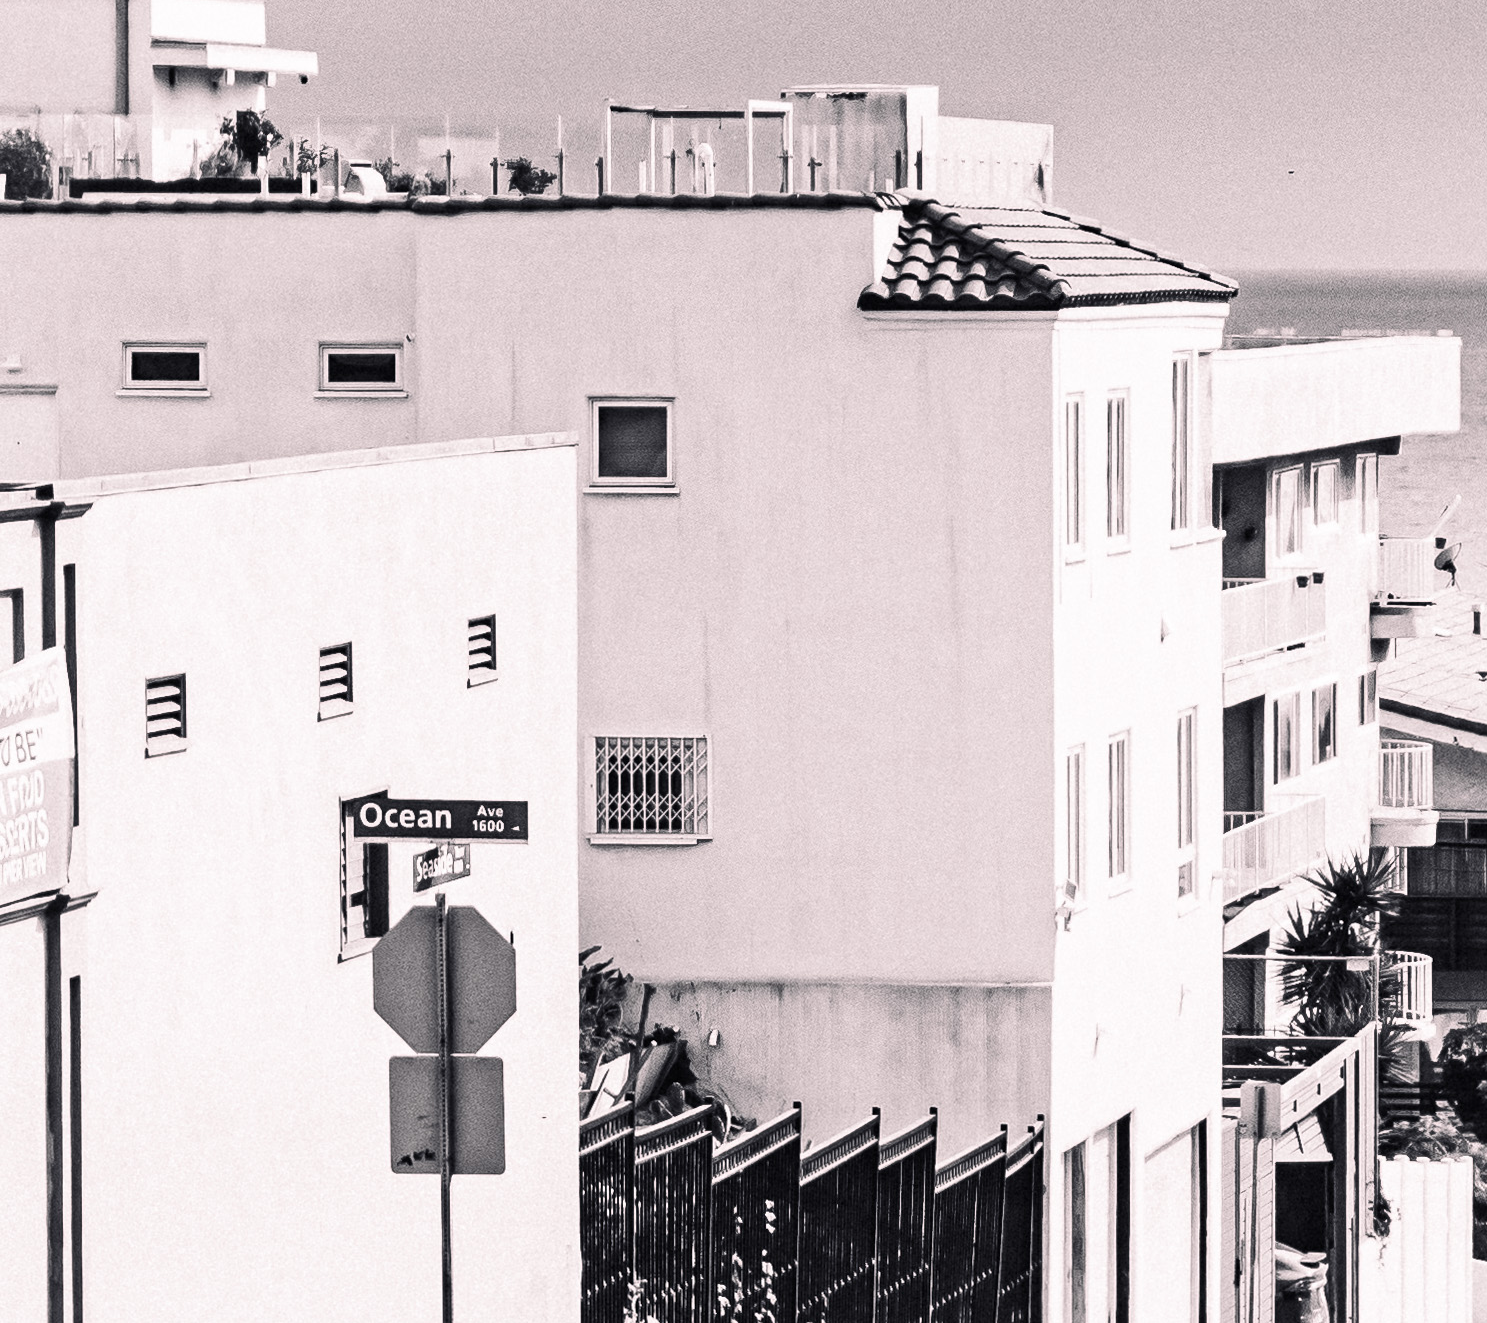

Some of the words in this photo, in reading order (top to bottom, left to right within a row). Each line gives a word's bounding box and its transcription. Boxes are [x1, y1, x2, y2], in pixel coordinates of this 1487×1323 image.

[360, 802, 452, 829] Ocean
[477, 804, 504, 818] Ave
[472, 819, 505, 832] 1600
[416, 844, 453, 882] Seaside
